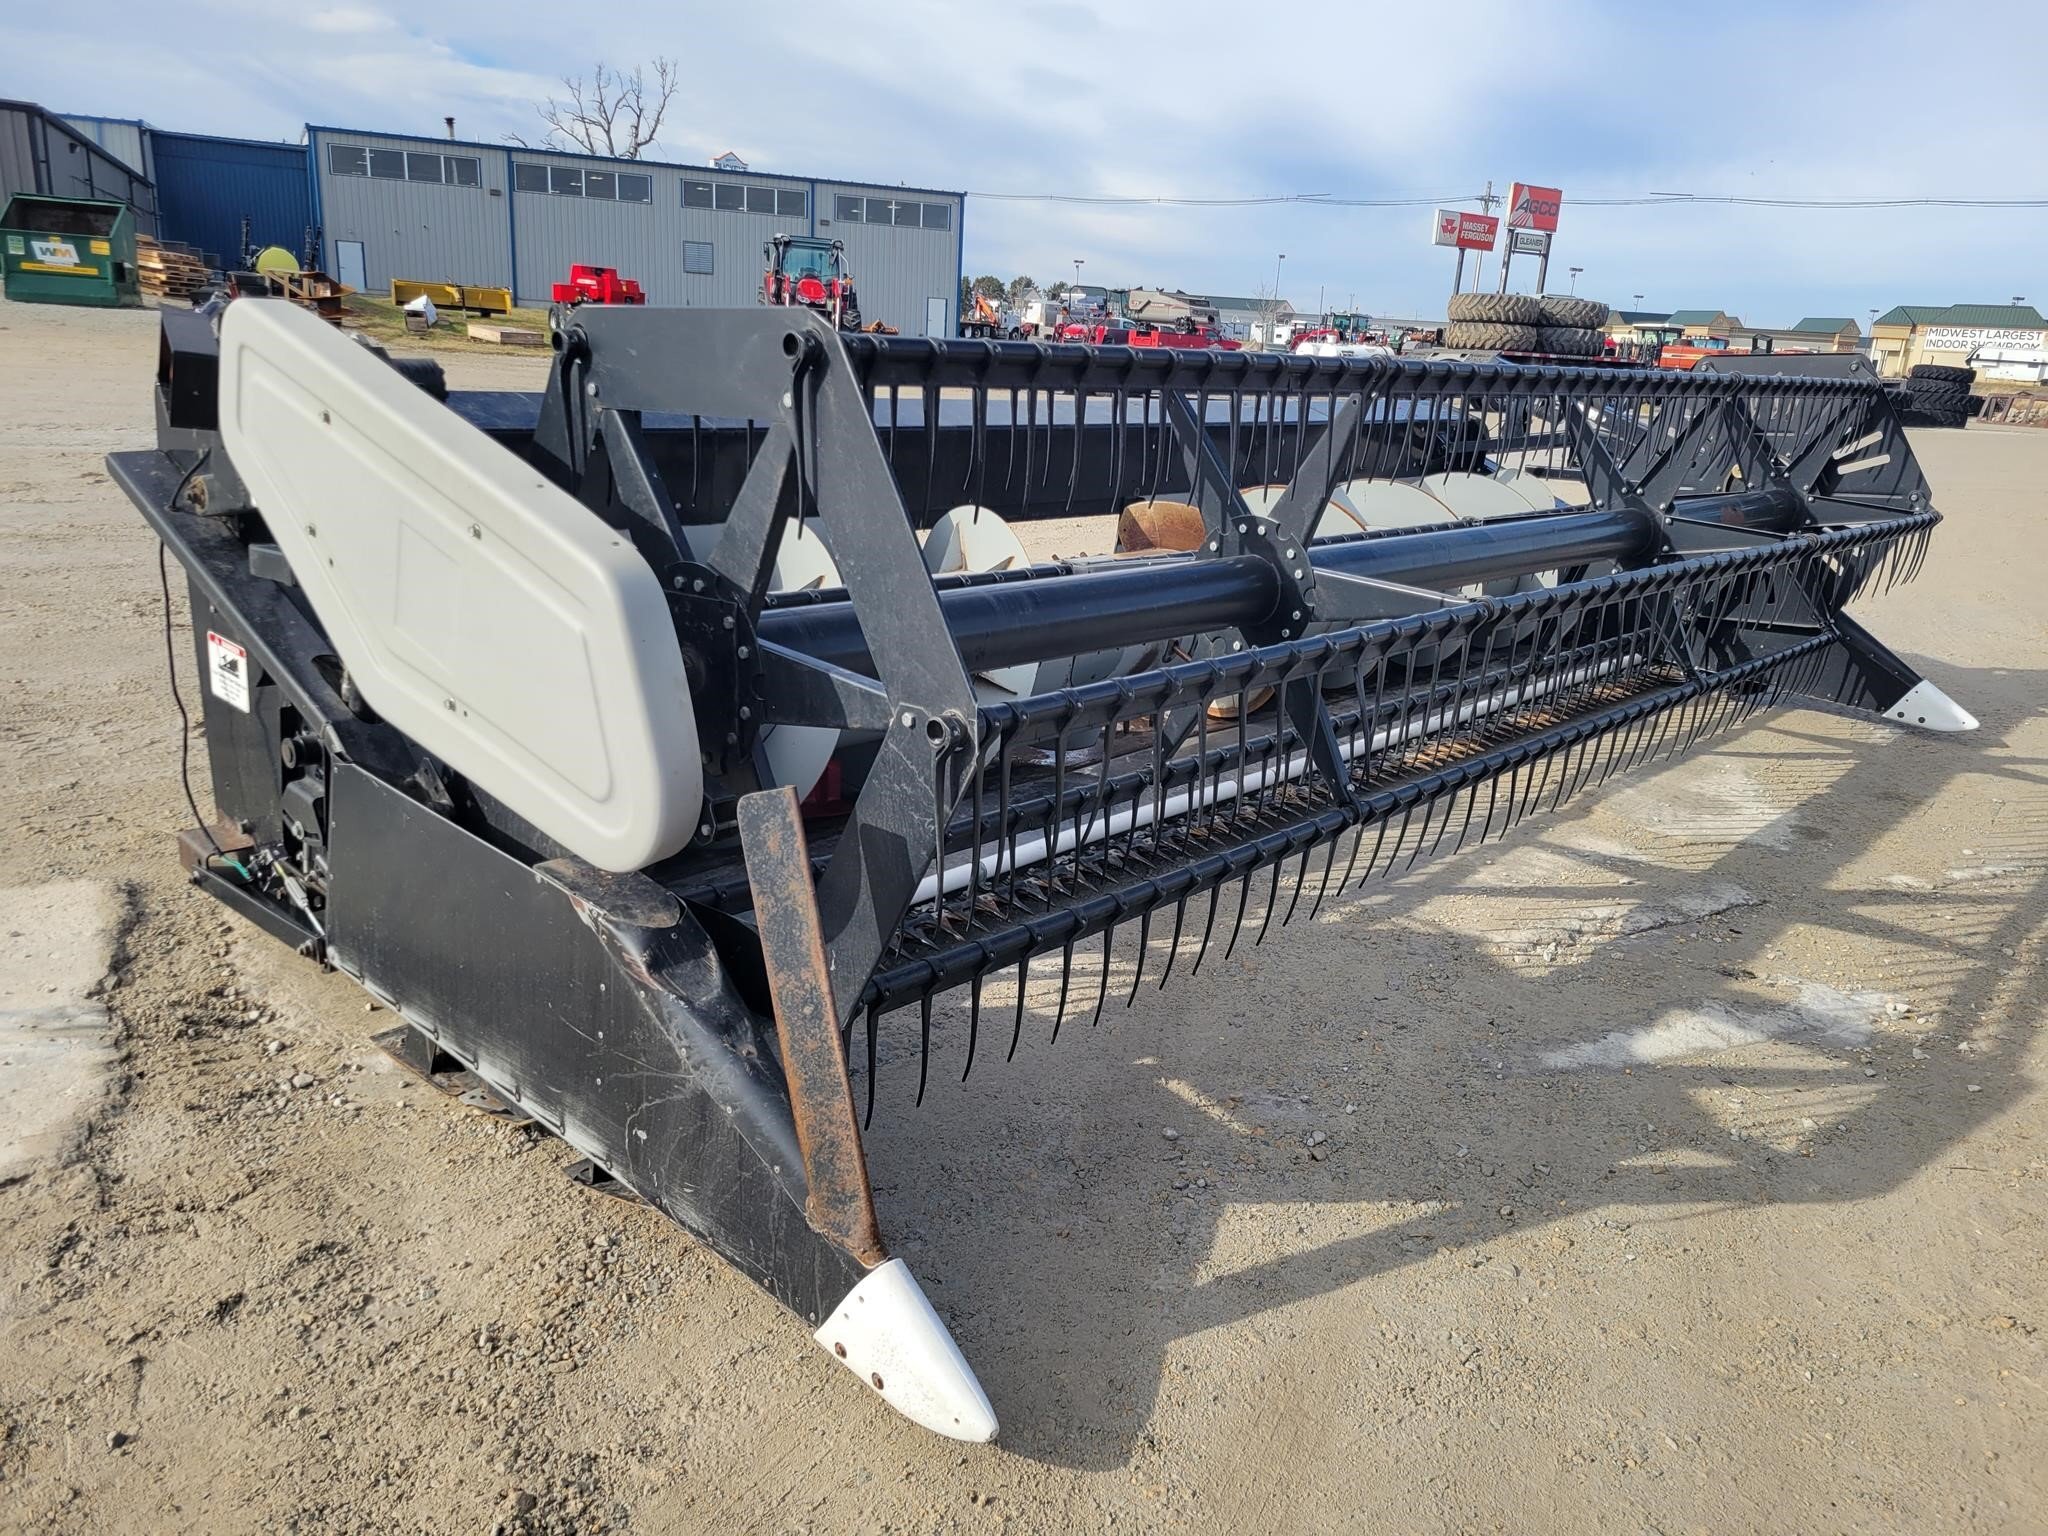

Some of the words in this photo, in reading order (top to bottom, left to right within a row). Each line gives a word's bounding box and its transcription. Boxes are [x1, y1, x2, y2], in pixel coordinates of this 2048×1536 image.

[1515, 198, 1558, 216] AGCO
[1463, 221, 1489, 233] MASSEY
[1461, 231, 1494, 242] FERGUSON
[1520, 238, 1543, 247] GLEANER
[39, 246, 73, 258] WM
[1928, 328, 1984, 338] MIDWEST
[1986, 330, 2043, 340] LARGEST
[1926, 339, 1968, 349] INDOOR
